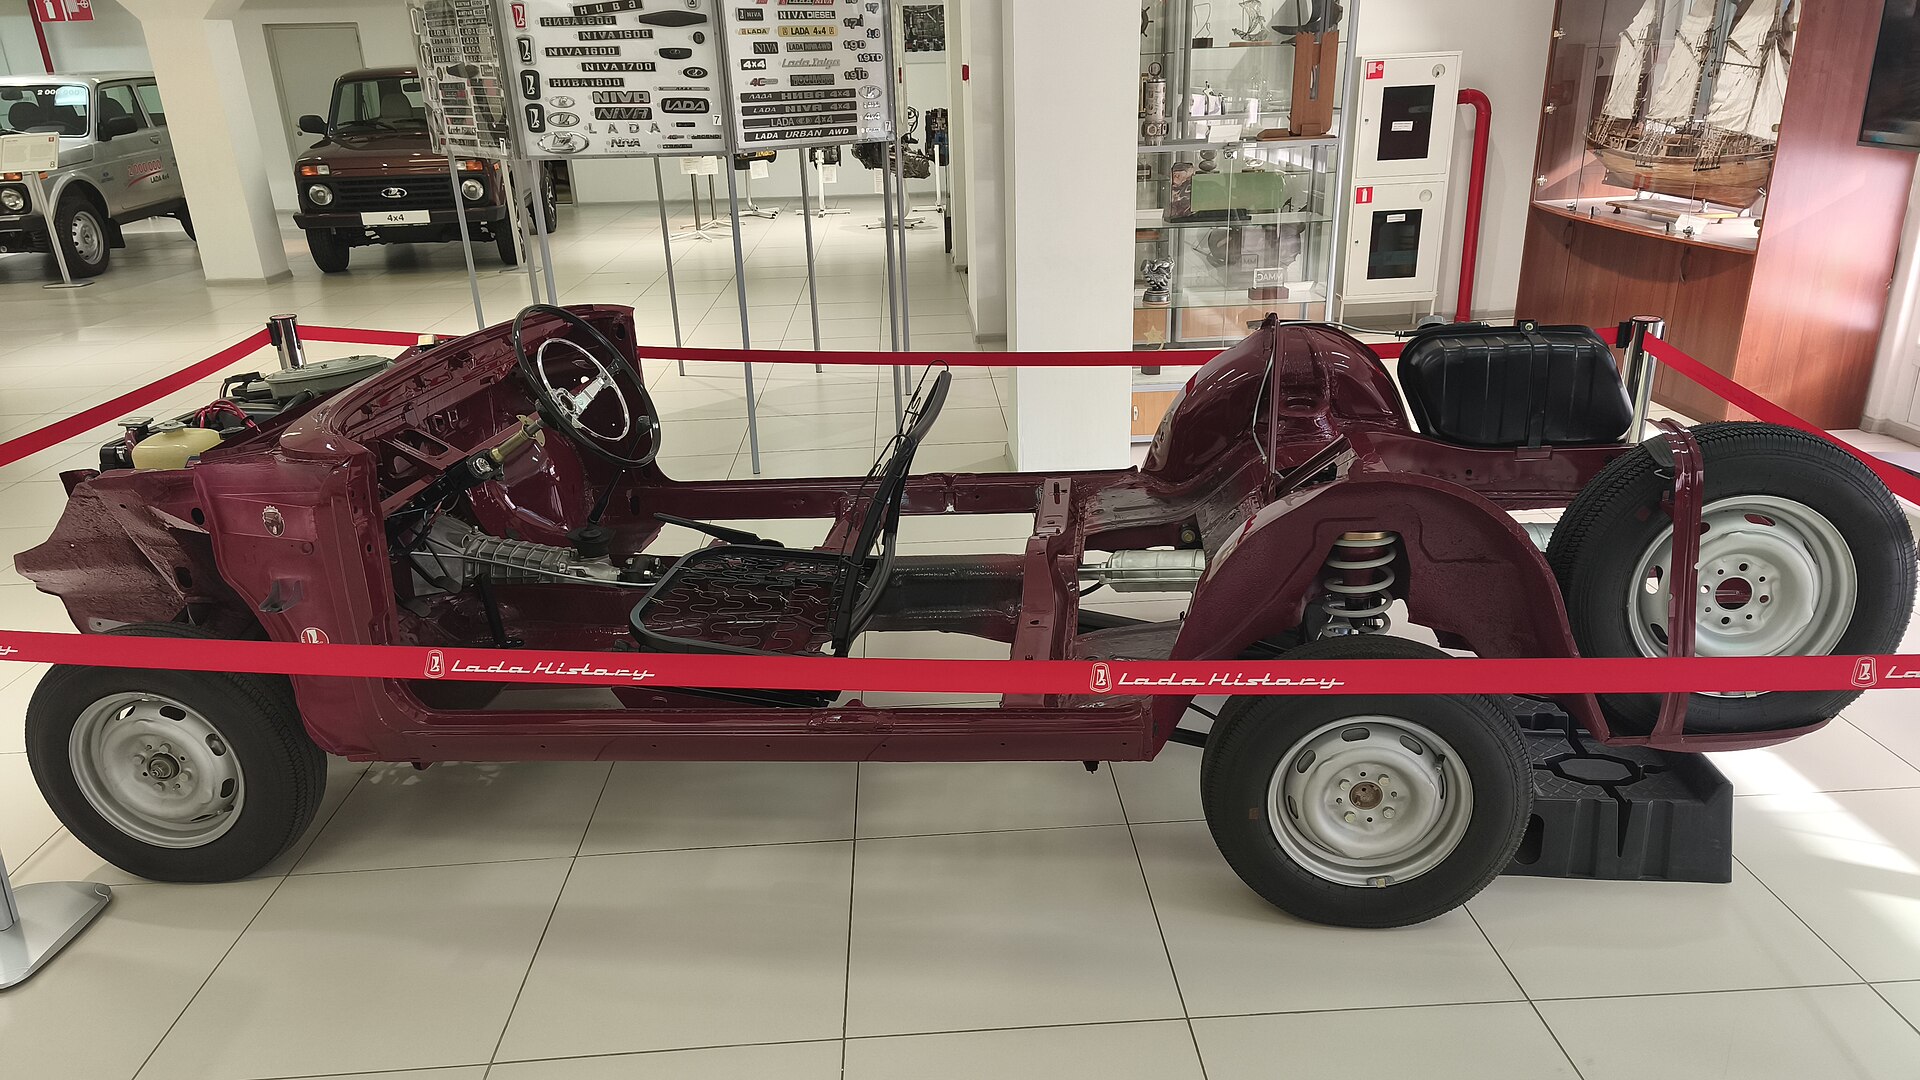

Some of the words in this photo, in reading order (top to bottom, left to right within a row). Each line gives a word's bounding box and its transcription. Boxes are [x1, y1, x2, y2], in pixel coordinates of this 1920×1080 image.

[780, 11, 806, 19] NIVA
[807, 11, 835, 19] DIESEL
[543, 17, 579, 26] НИВА
[582, 31, 617, 40] NIVA
[619, 30, 649, 38] 1600
[813, 27, 826, 35] 4x4
[548, 48, 582, 56] NIVA
[755, 43, 778, 53] NIVA
[585, 63, 619, 71] NIVA
[621, 63, 652, 71] 1700
[743, 61, 766, 69] 4x4
[782, 58, 810, 67] Lada
[552, 79, 588, 87] НИВА
[593, 92, 650, 103] NIVA
[665, 100, 706, 111] LADA
[785, 104, 823, 113] NIVA
[714, 115, 720, 124] 7
[771, 118, 795, 127] LADA
[588, 122, 661, 134] LADA
[755, 132, 779, 140] LADA
[785, 130, 822, 139] URBAN
[828, 128, 849, 136] AWD
[387, 214, 404, 222] 4x4
[451, 659, 530, 674] Lada
[532, 661, 655, 681] History
[1117, 673, 1206, 686] Lada
[1207, 672, 1345, 690] History
